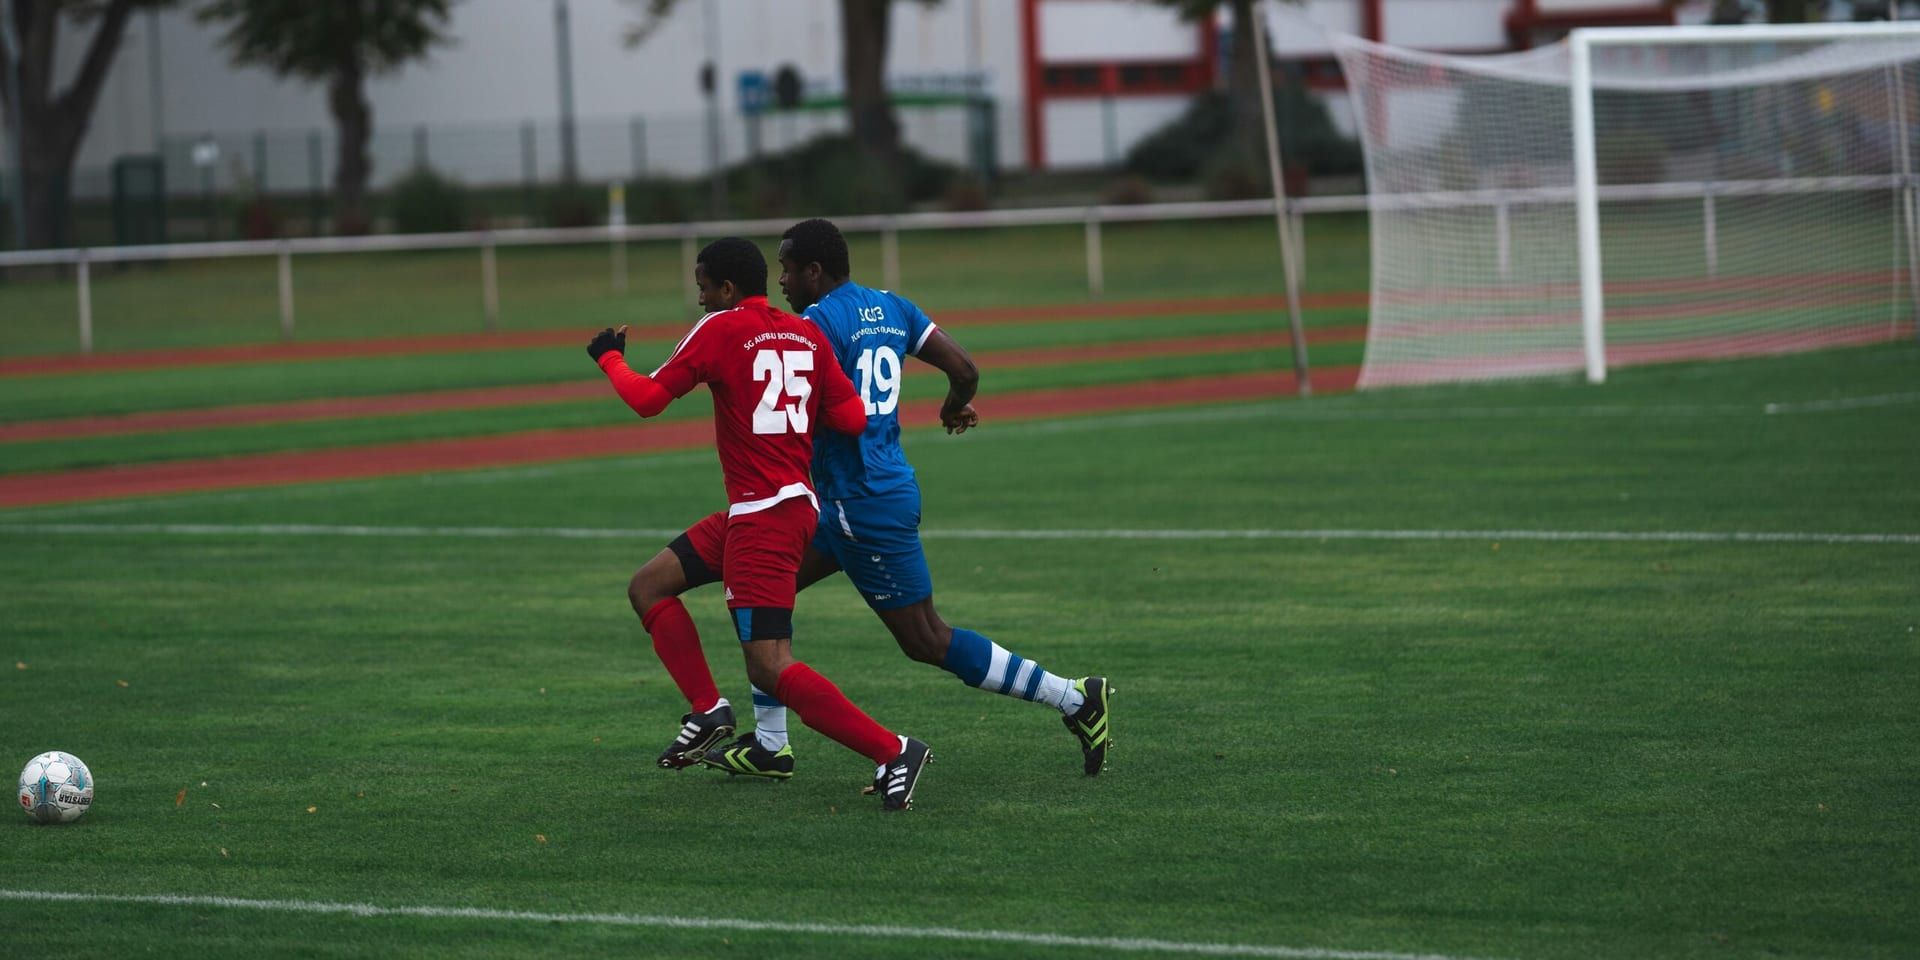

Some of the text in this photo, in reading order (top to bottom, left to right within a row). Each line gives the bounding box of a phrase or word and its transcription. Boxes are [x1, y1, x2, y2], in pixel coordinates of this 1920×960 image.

[743, 340, 755, 351] SG
[856, 345, 901, 416] 19
[752, 349, 814, 434] 25
